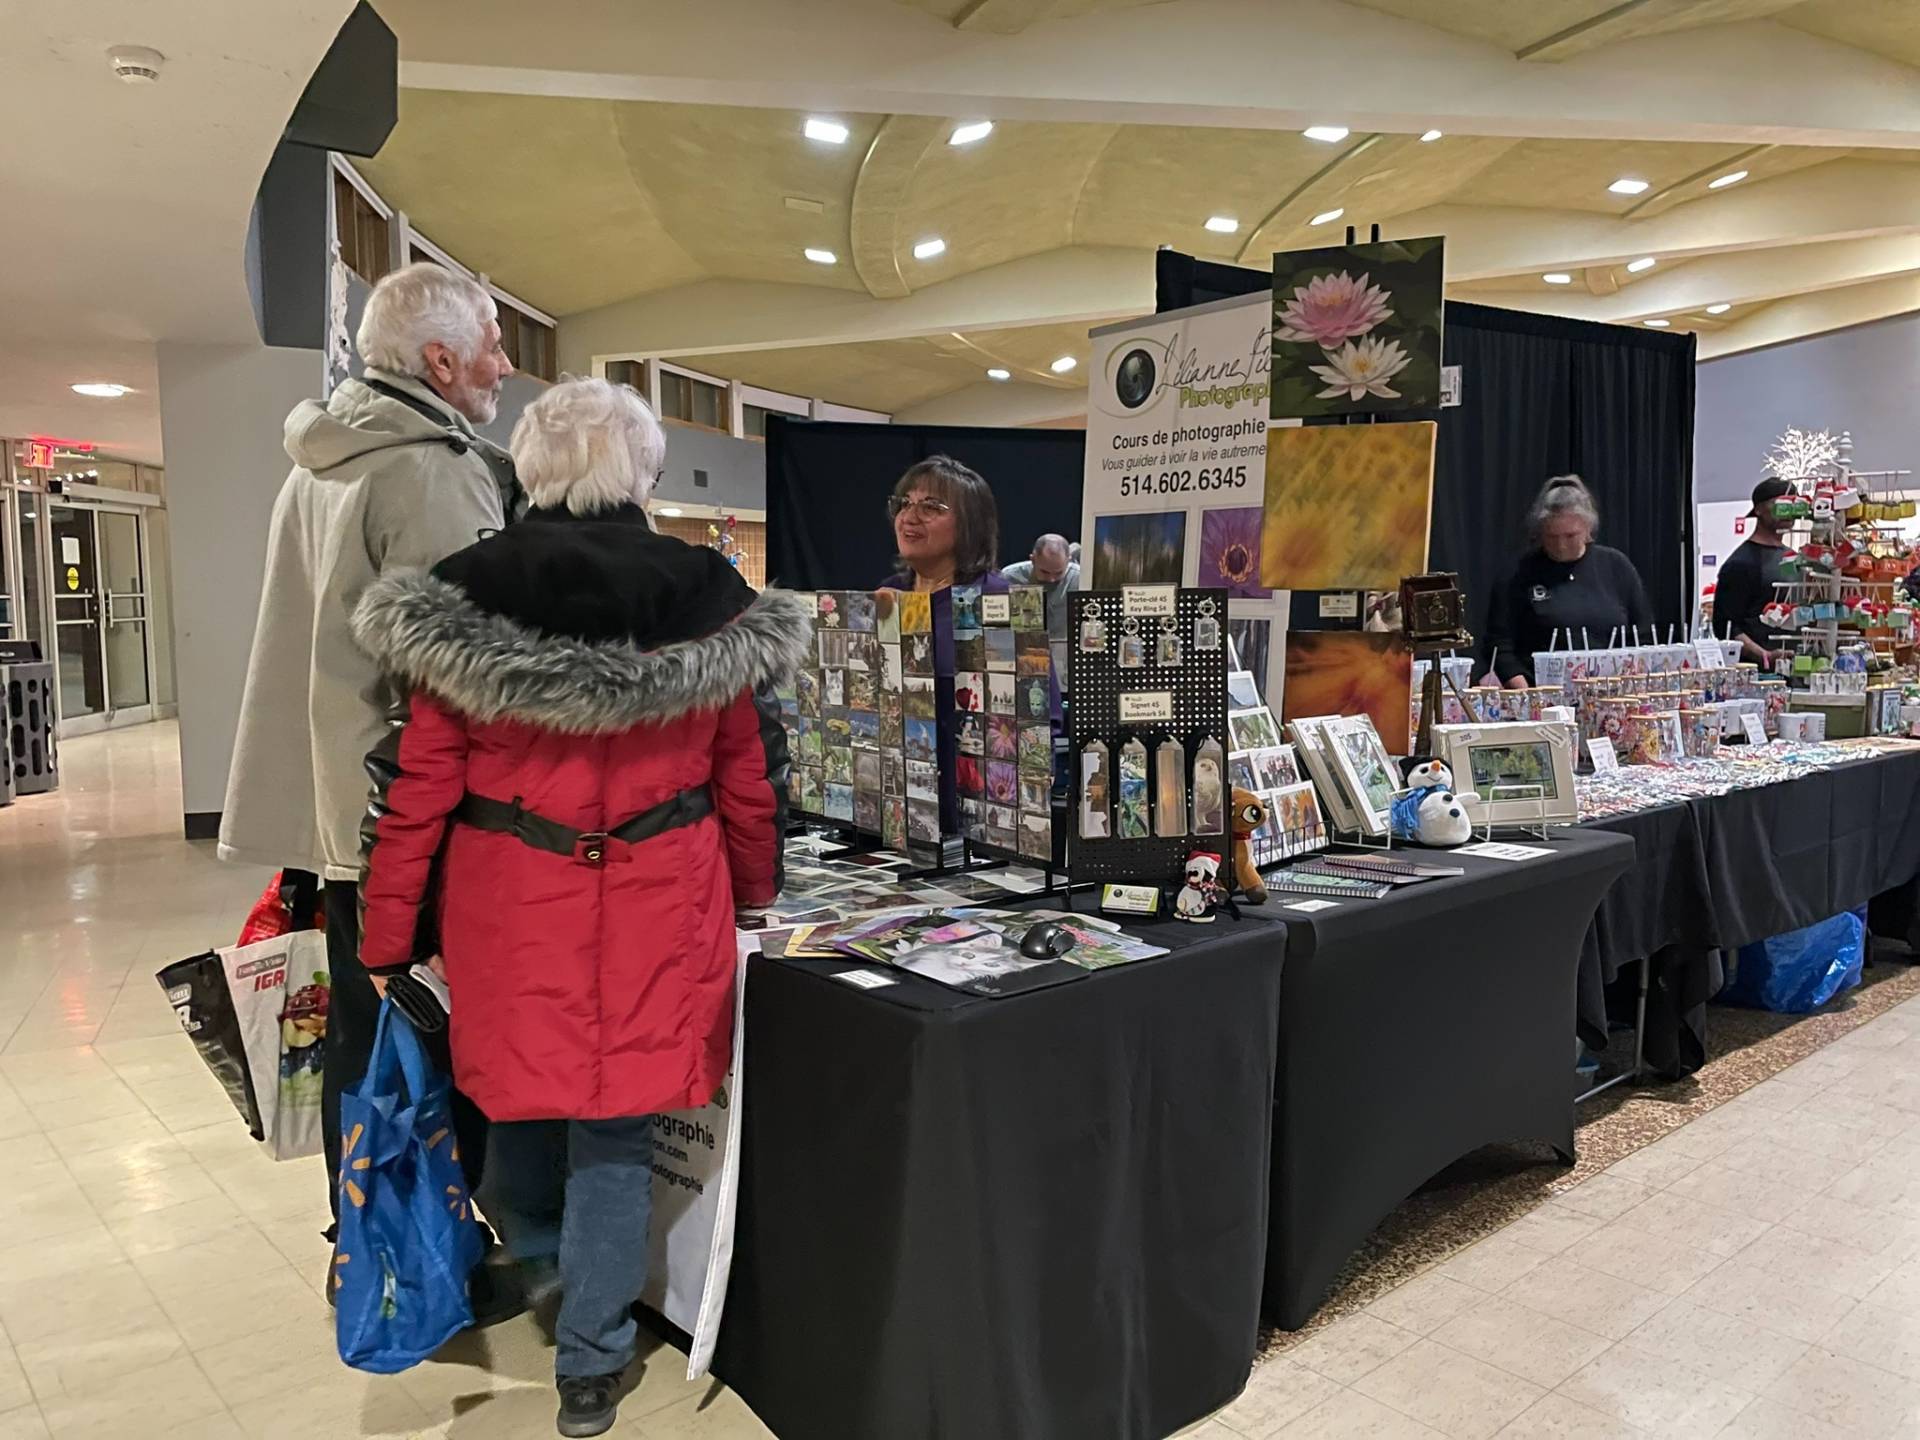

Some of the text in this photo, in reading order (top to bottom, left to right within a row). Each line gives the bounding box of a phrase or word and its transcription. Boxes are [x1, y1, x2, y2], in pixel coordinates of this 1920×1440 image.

[1179, 377, 1270, 409] Photograp
[1112, 418, 1266, 450] Cours de photographie
[1102, 444, 1266, 472] Vous guider à voir la vie autreme
[1120, 465, 1247, 497] 514.602.6345
[254, 969, 285, 993] IGA
